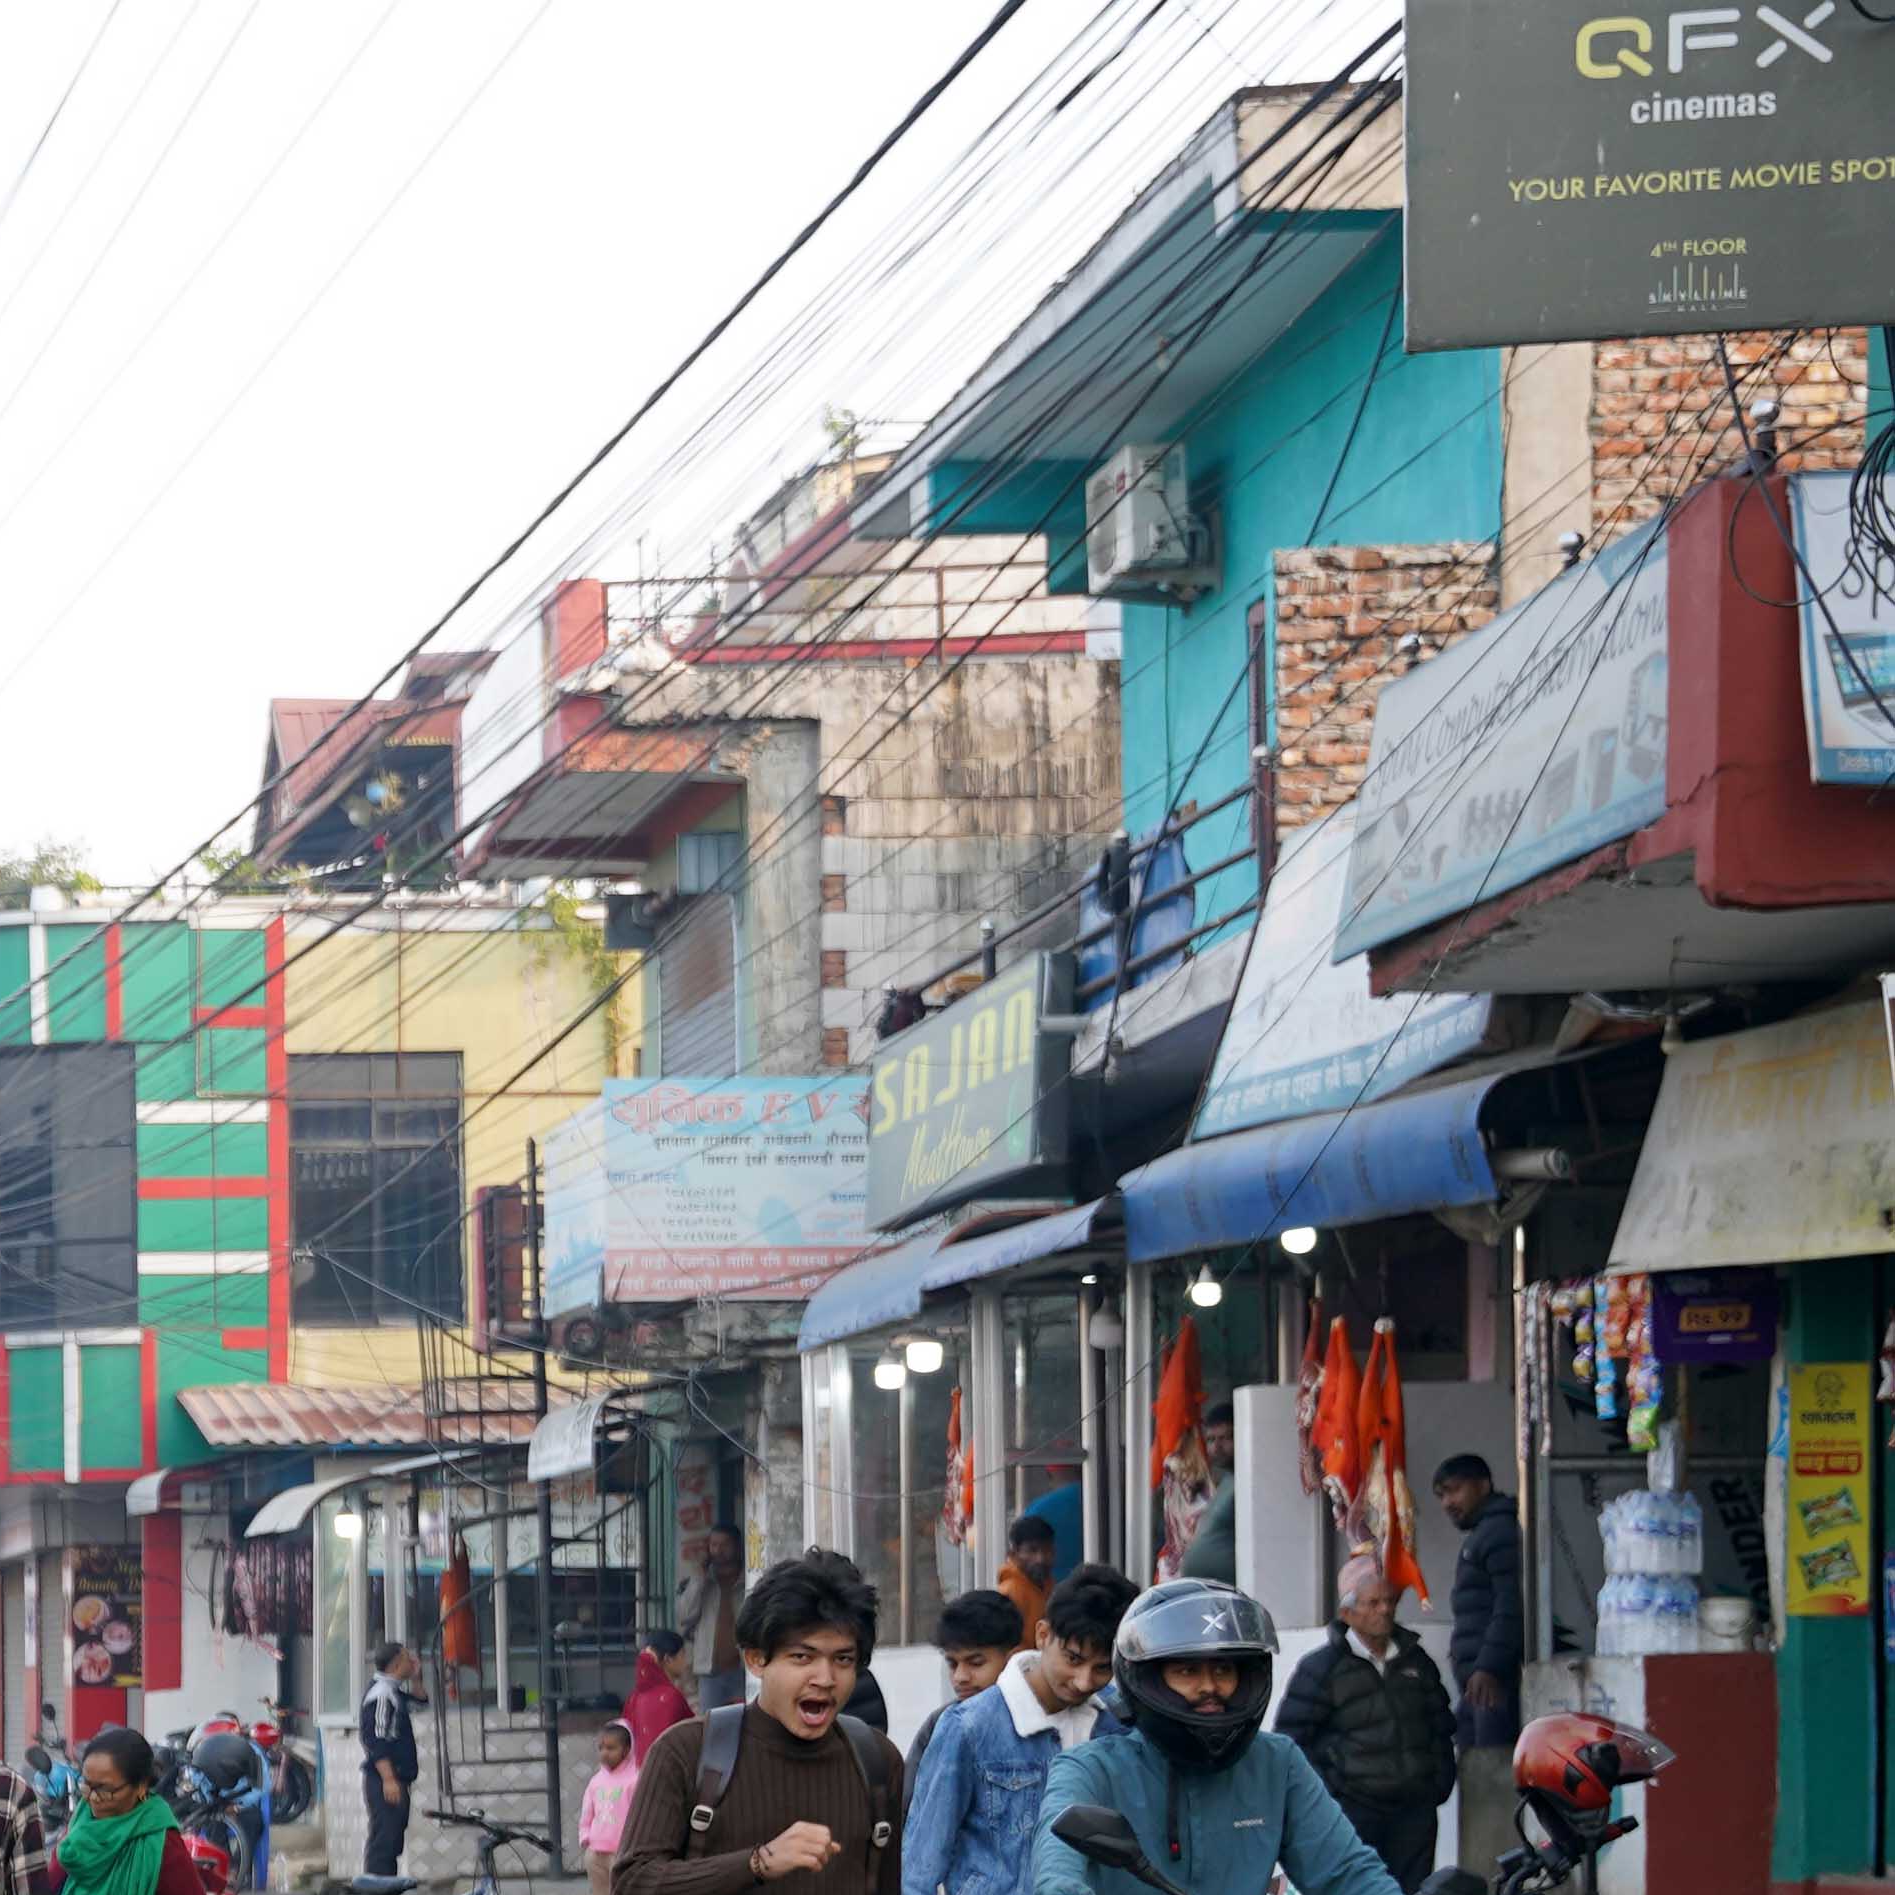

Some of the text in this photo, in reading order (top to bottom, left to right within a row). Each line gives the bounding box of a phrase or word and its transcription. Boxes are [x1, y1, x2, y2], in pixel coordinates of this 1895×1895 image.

[1576, 1, 1836, 79] QFX
[1630, 91, 1777, 124] cinemas
[1509, 177, 1586, 202] YOUR
[1595, 168, 1722, 198] FAVORITE
[1730, 162, 1822, 190] MOVIE
[1682, 238, 1747, 257] FLOOR
[610, 1087, 745, 1135] यूनिक
[760, 1092, 792, 1123] E
[806, 1092, 841, 1123] V
